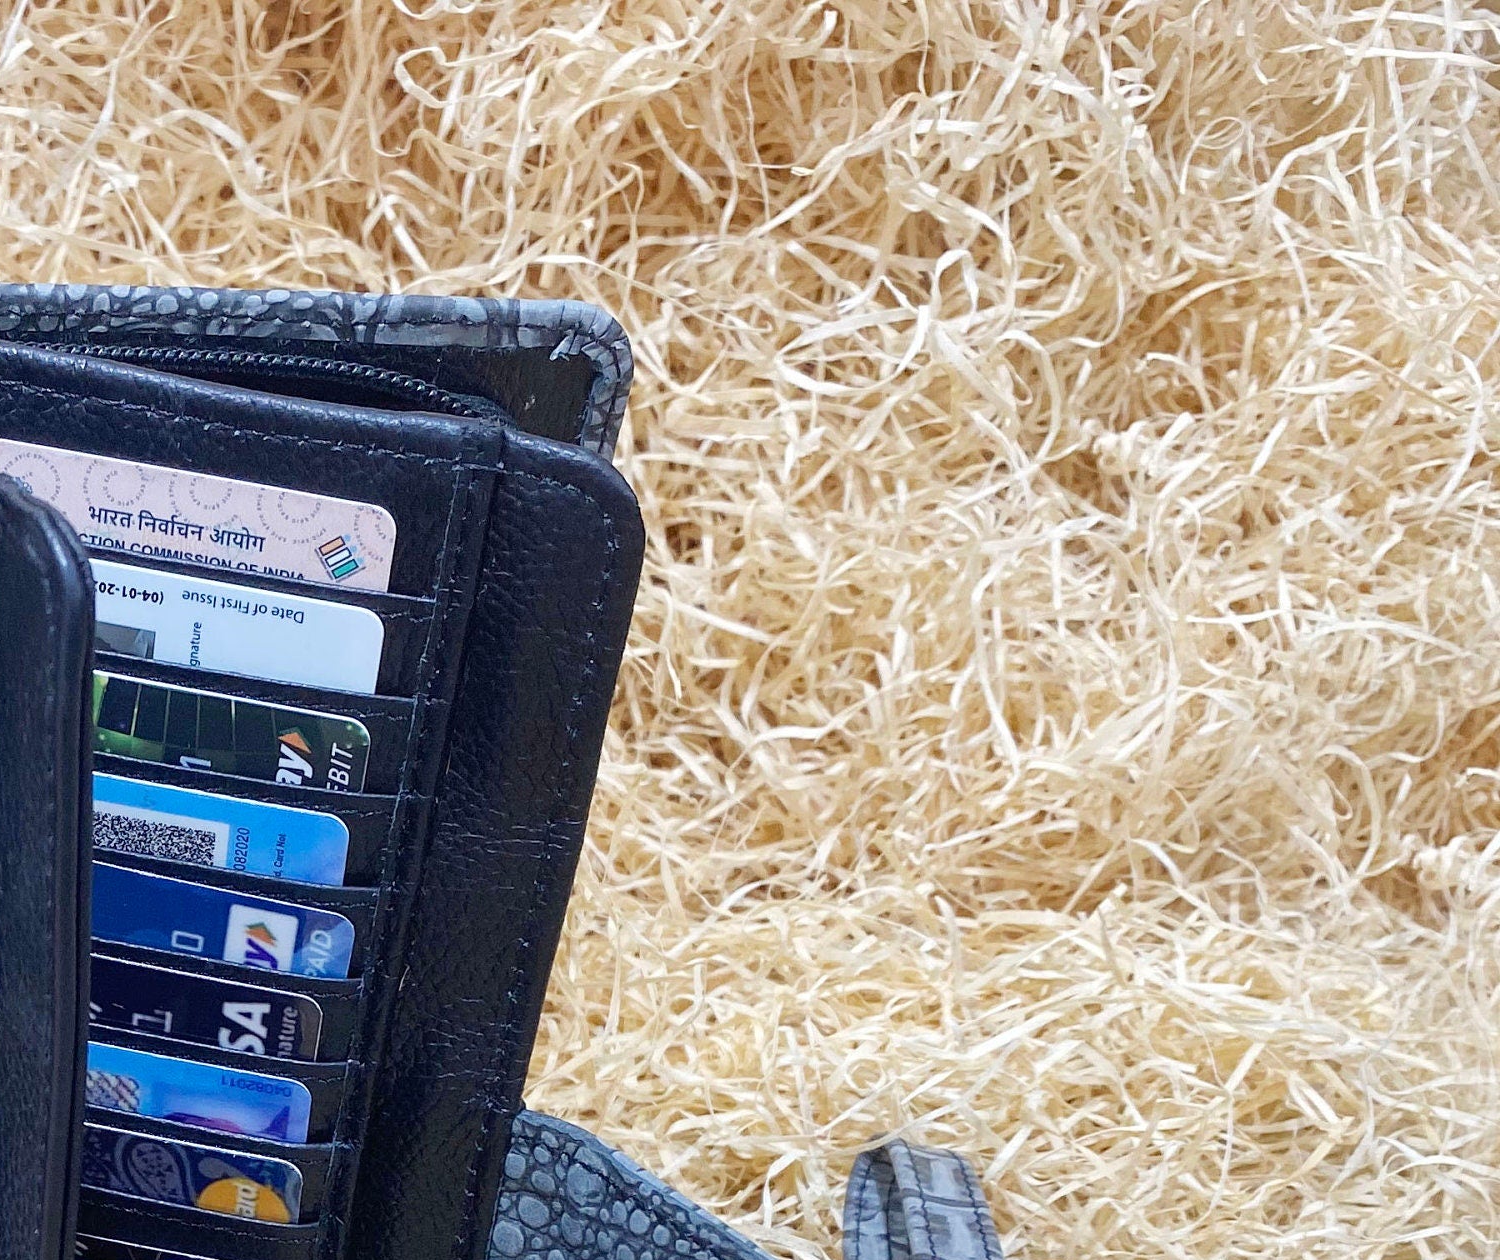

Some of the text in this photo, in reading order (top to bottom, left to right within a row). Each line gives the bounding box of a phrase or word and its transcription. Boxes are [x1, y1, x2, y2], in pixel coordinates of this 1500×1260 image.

[89, 506, 265, 552] भारत निर्वाचन आयोग
[96, 581, 164, 605] (04-01-20
[182, 590, 305, 625] Date of First Issue
